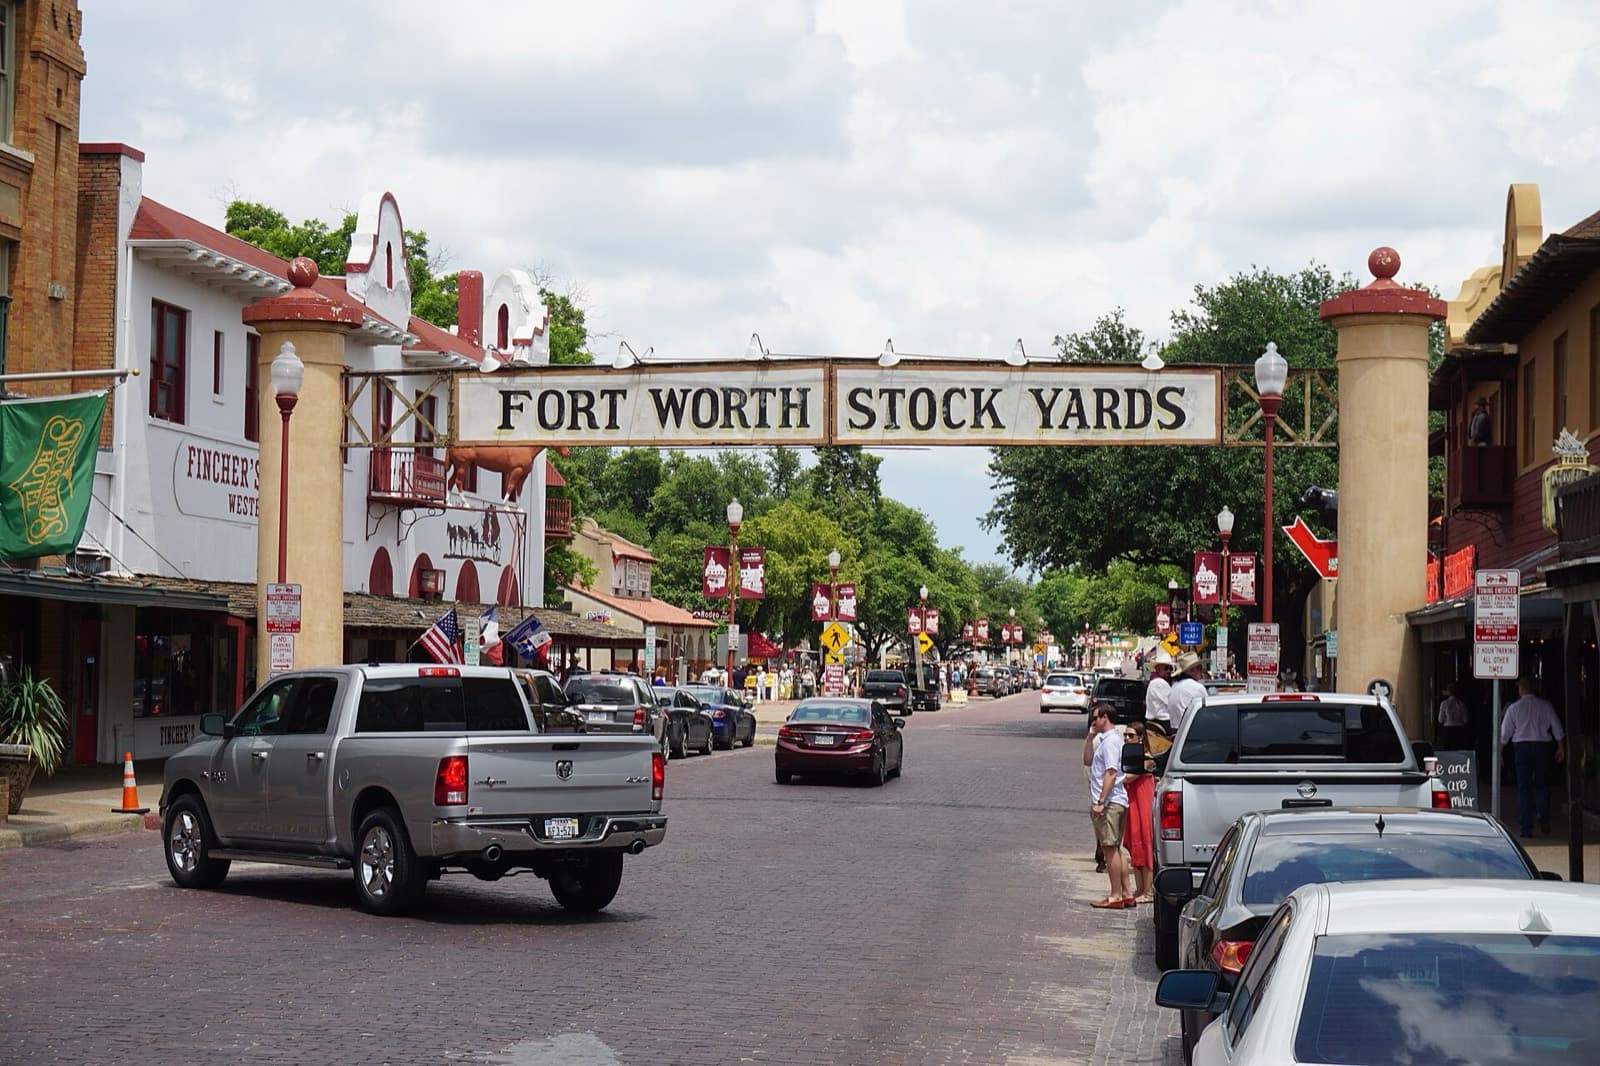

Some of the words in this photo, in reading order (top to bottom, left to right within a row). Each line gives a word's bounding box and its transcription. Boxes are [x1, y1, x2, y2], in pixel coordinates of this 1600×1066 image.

[497, 388, 628, 431] FORT
[649, 386, 812, 430] WORTH
[847, 386, 1006, 431] STOCK
[1028, 385, 1187, 431] YARDS
[22, 449, 54, 513] HOTEL
[30, 419, 83, 539] STOCKYARDS
[1483, 656, 1491, 664] ALL
[1493, 656, 1509, 664] OTHER
[160, 724, 195, 746] FINCHER'S
[1448, 758, 1470, 775] and
[1447, 779, 1468, 792] are
